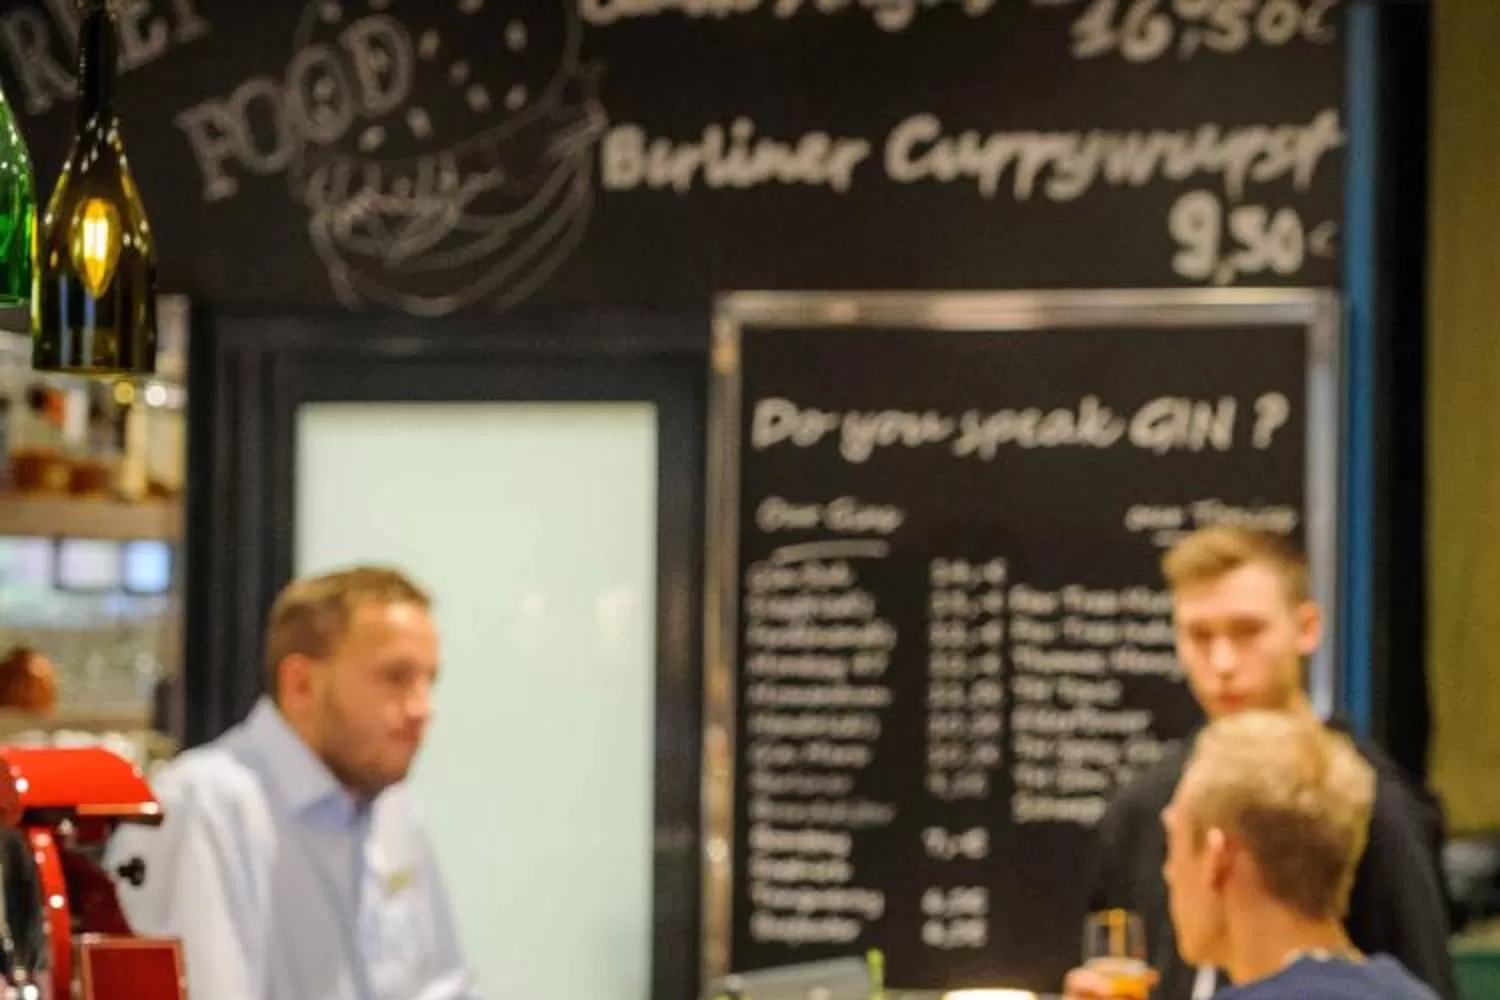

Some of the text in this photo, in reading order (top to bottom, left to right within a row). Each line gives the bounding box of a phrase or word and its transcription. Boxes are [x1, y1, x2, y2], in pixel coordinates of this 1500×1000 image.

[176, 15, 411, 199] FOOD
[603, 110, 1345, 200] Berliner Currywurst
[752, 397, 838, 449] Do
[839, 409, 953, 463] you
[953, 396, 1127, 460] speak
[1128, 396, 1236, 454] GIN
